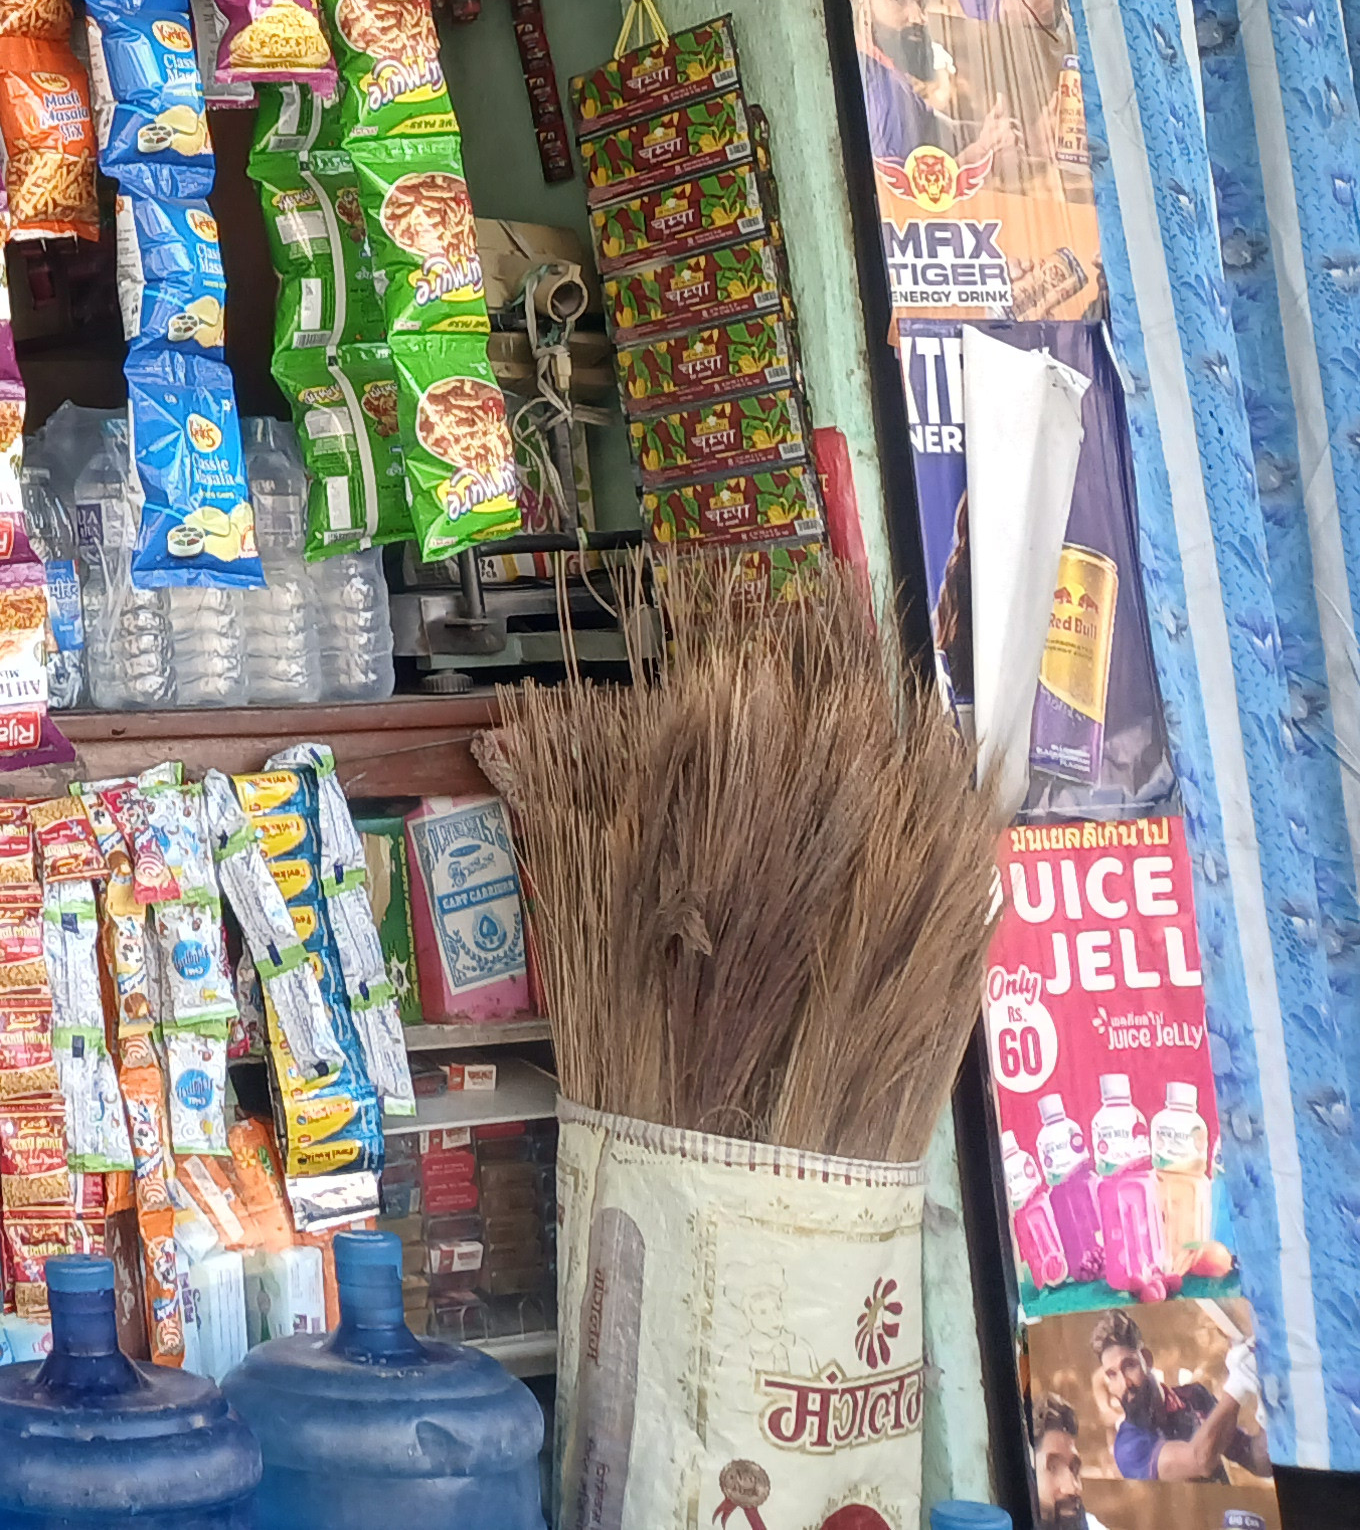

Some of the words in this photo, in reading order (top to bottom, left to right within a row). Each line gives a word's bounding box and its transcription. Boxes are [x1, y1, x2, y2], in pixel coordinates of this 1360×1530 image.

[44, 91, 79, 109] Masti
[41, 108, 89, 124] Masala
[883, 220, 1002, 260] MAX
[888, 261, 1008, 288] TIGER
[957, 290, 1010, 304] DRINK
[1047, 612, 1074, 632] Red
[1074, 616, 1098, 641] Bull
[988, 968, 1042, 1006] Only
[1007, 1005, 1029, 1023] Rs.
[998, 1025, 1044, 1079] 60
